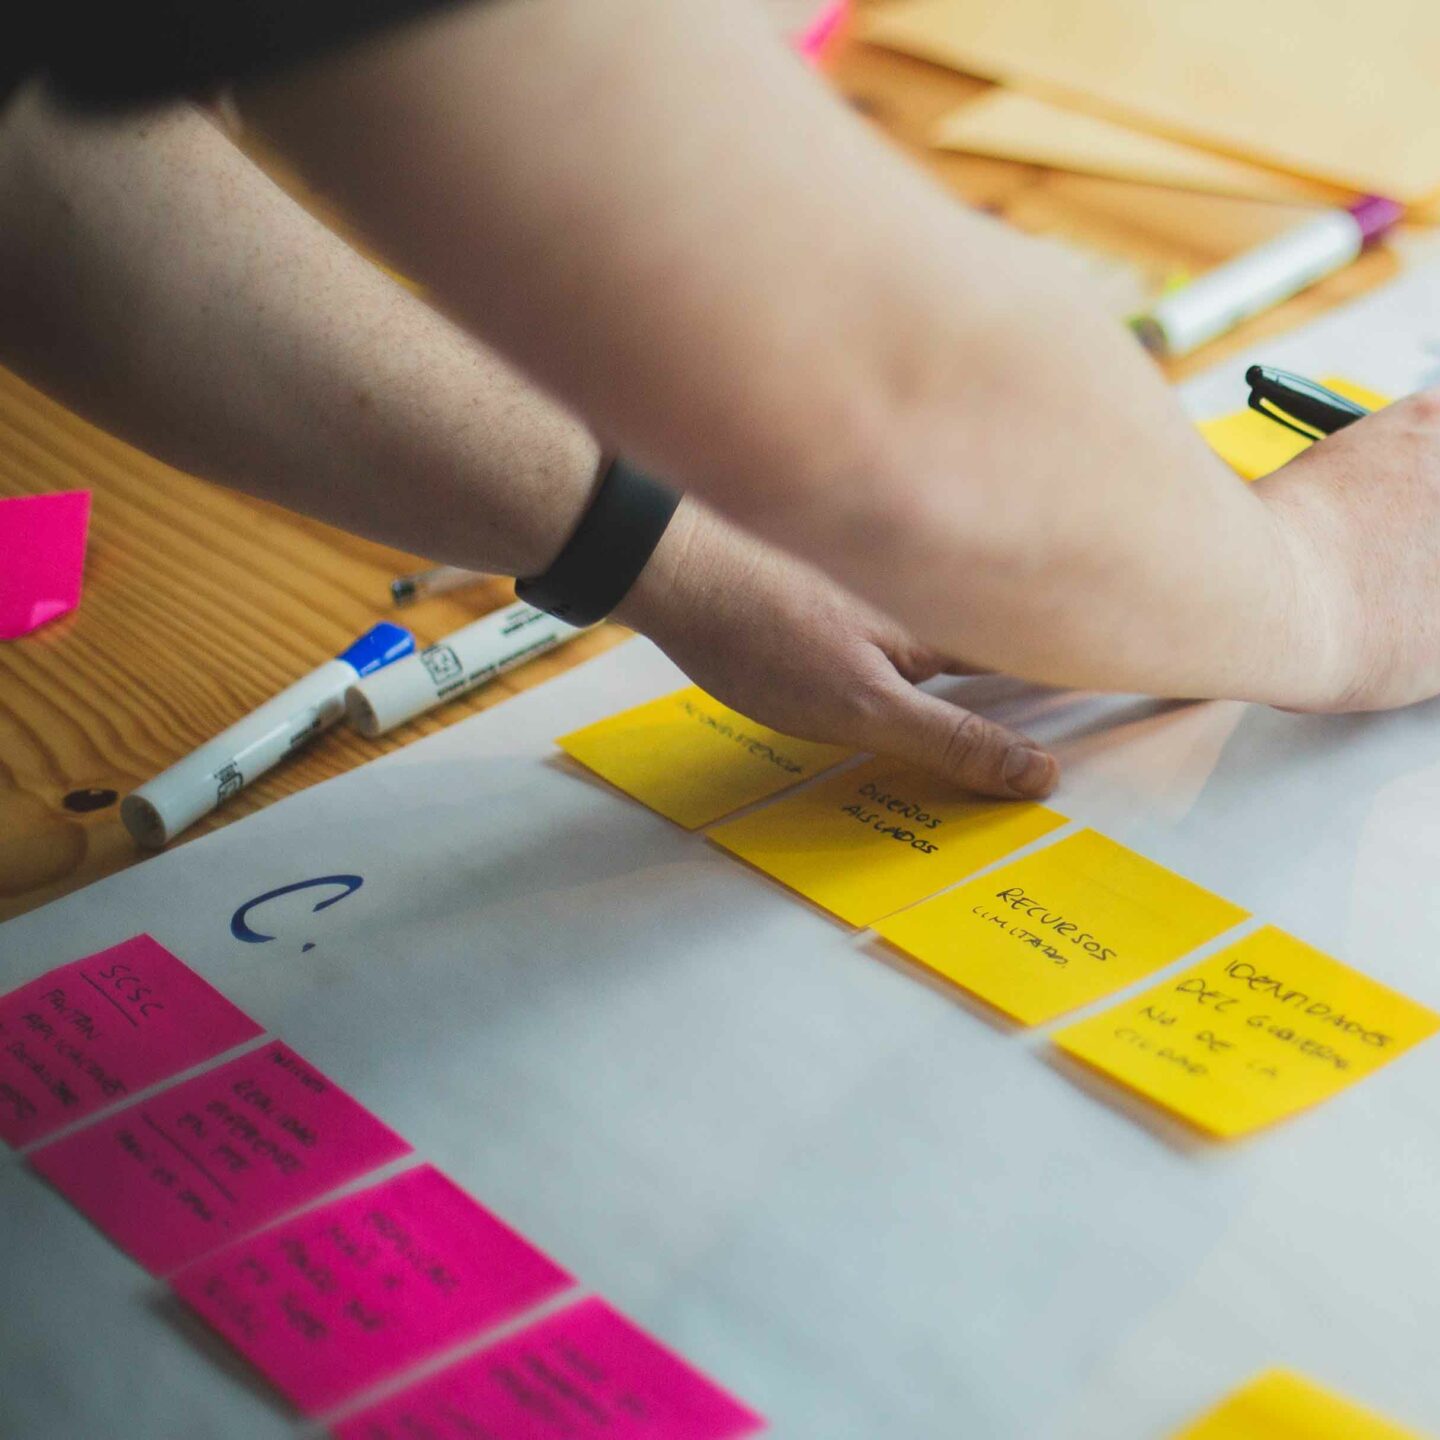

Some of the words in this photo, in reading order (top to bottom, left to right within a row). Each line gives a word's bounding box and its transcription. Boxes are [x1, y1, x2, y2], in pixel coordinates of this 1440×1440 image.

[996, 887, 1118, 961] RECURSOS
[1138, 1005, 1178, 1026] NO
[1175, 978, 1241, 1012] DEL
[1224, 960, 1393, 1047] IDENTIDADES
